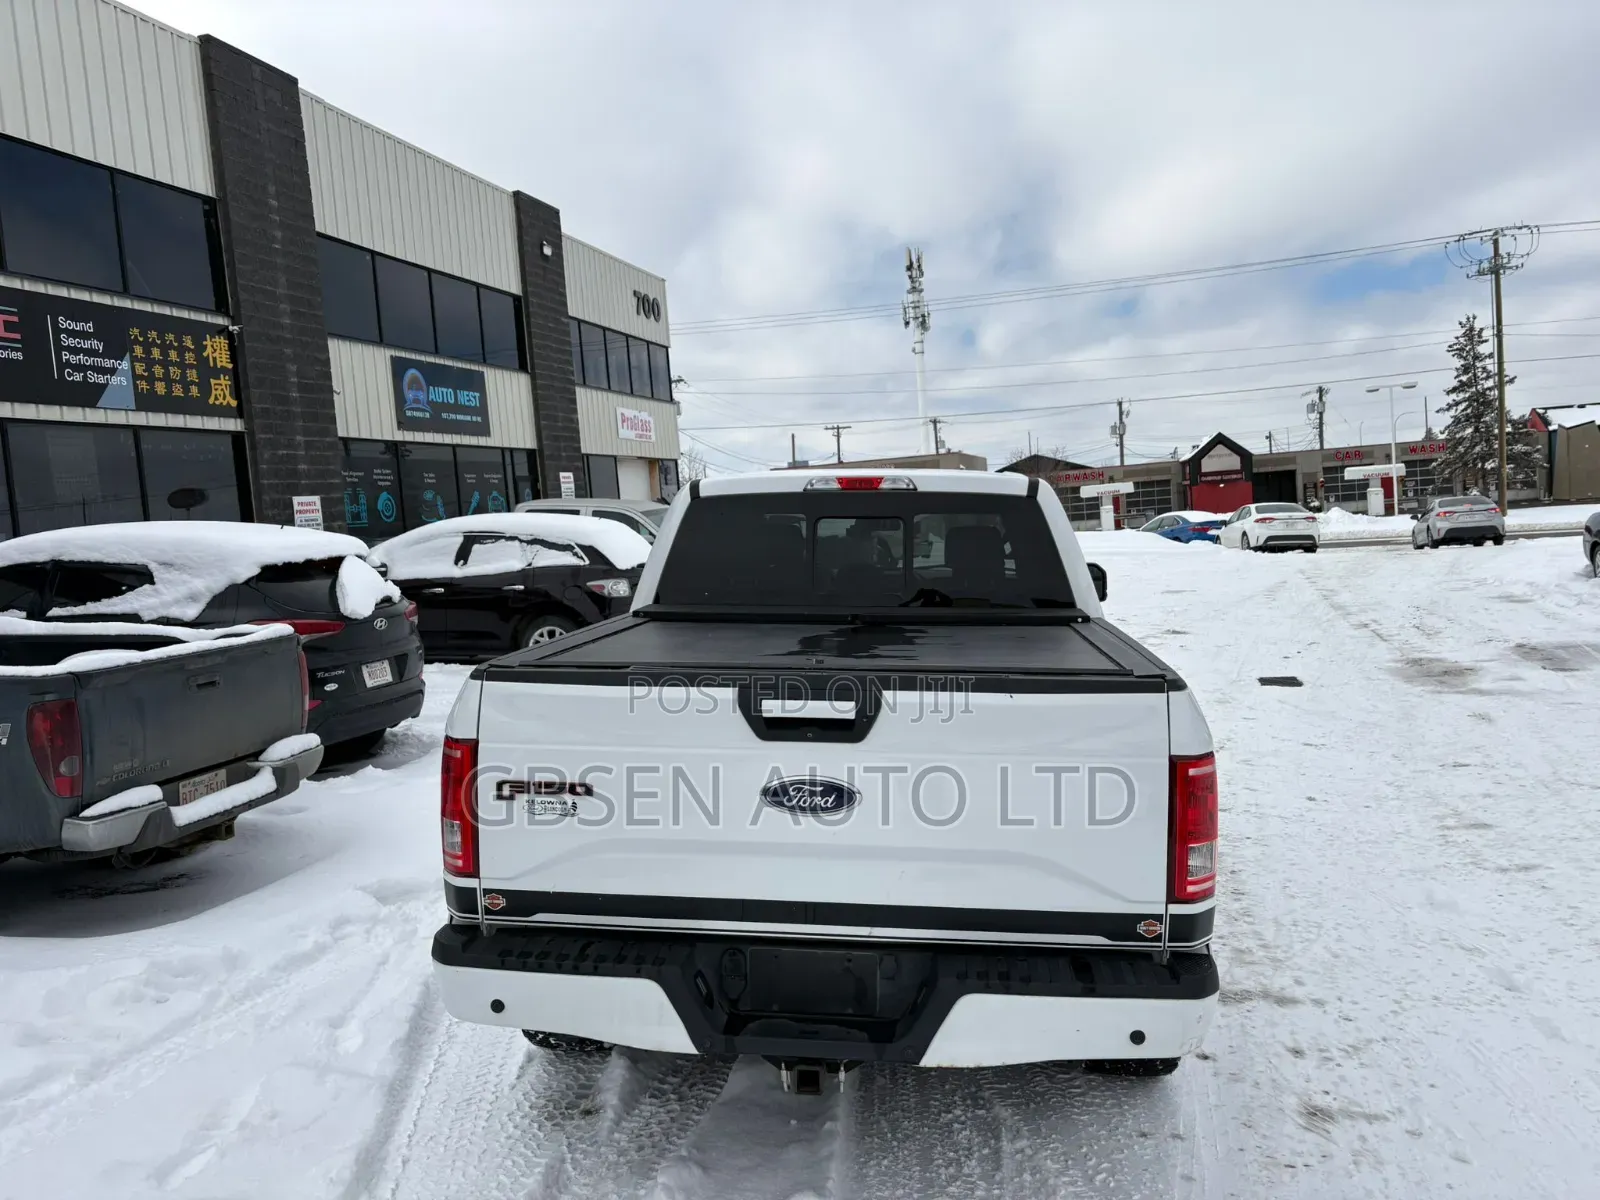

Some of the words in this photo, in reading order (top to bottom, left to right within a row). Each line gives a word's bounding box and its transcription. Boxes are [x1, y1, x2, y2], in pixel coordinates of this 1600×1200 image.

[633, 289, 661, 323] 700
[58, 316, 94, 332] Sound
[60, 333, 104, 353] Security
[62, 351, 129, 370] Performance
[64, 368, 84, 382] Car
[87, 371, 127, 386] Starters
[429, 386, 455, 405] AUTO
[456, 389, 480, 407] NEST
[1335, 449, 1363, 461] CAR
[1408, 442, 1447, 455] WASH
[316, 669, 345, 678] TUCSON
[783, 784, 838, 808] Ford
